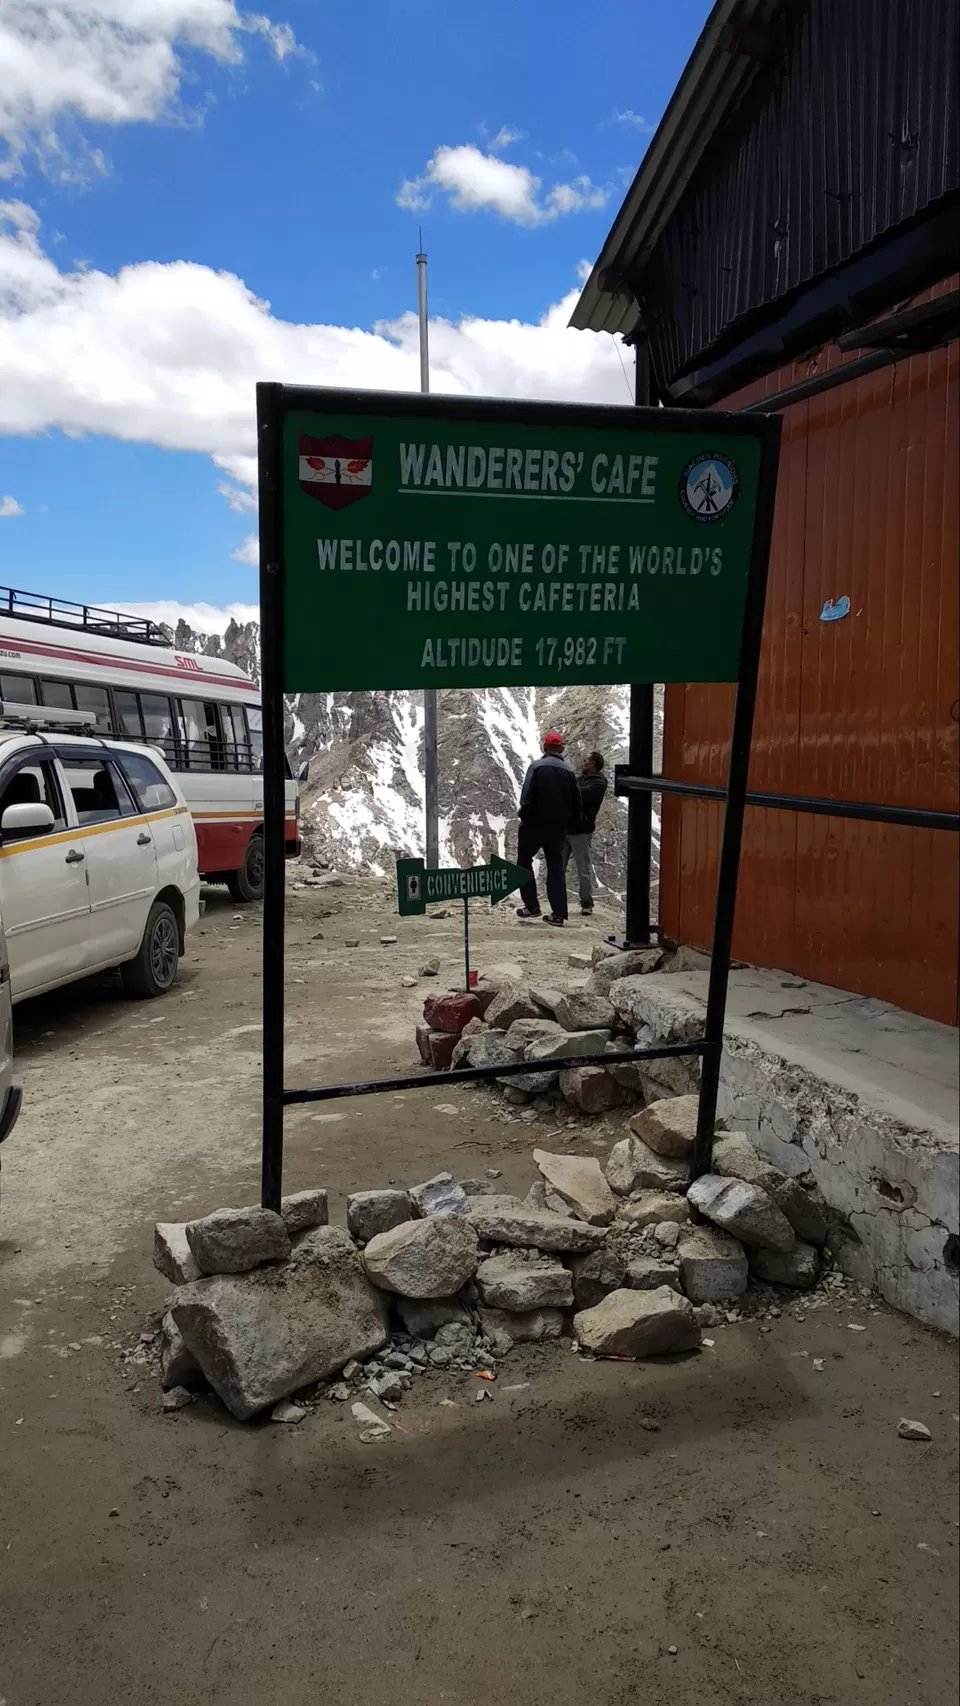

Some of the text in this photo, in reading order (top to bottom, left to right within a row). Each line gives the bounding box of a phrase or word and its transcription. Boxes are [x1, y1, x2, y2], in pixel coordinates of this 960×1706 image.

[399, 442, 659, 496] WANDERERS' CAFE
[317, 538, 722, 576] WELCOME TO ONE OF THE WORLD'S
[407, 581, 641, 612] HIGHEST CAFETERIA
[174, 655, 203, 670] SML
[420, 636, 627, 672] ALTIDUDE 17,982 FT
[427, 869, 508, 897] CONVENIENCE
